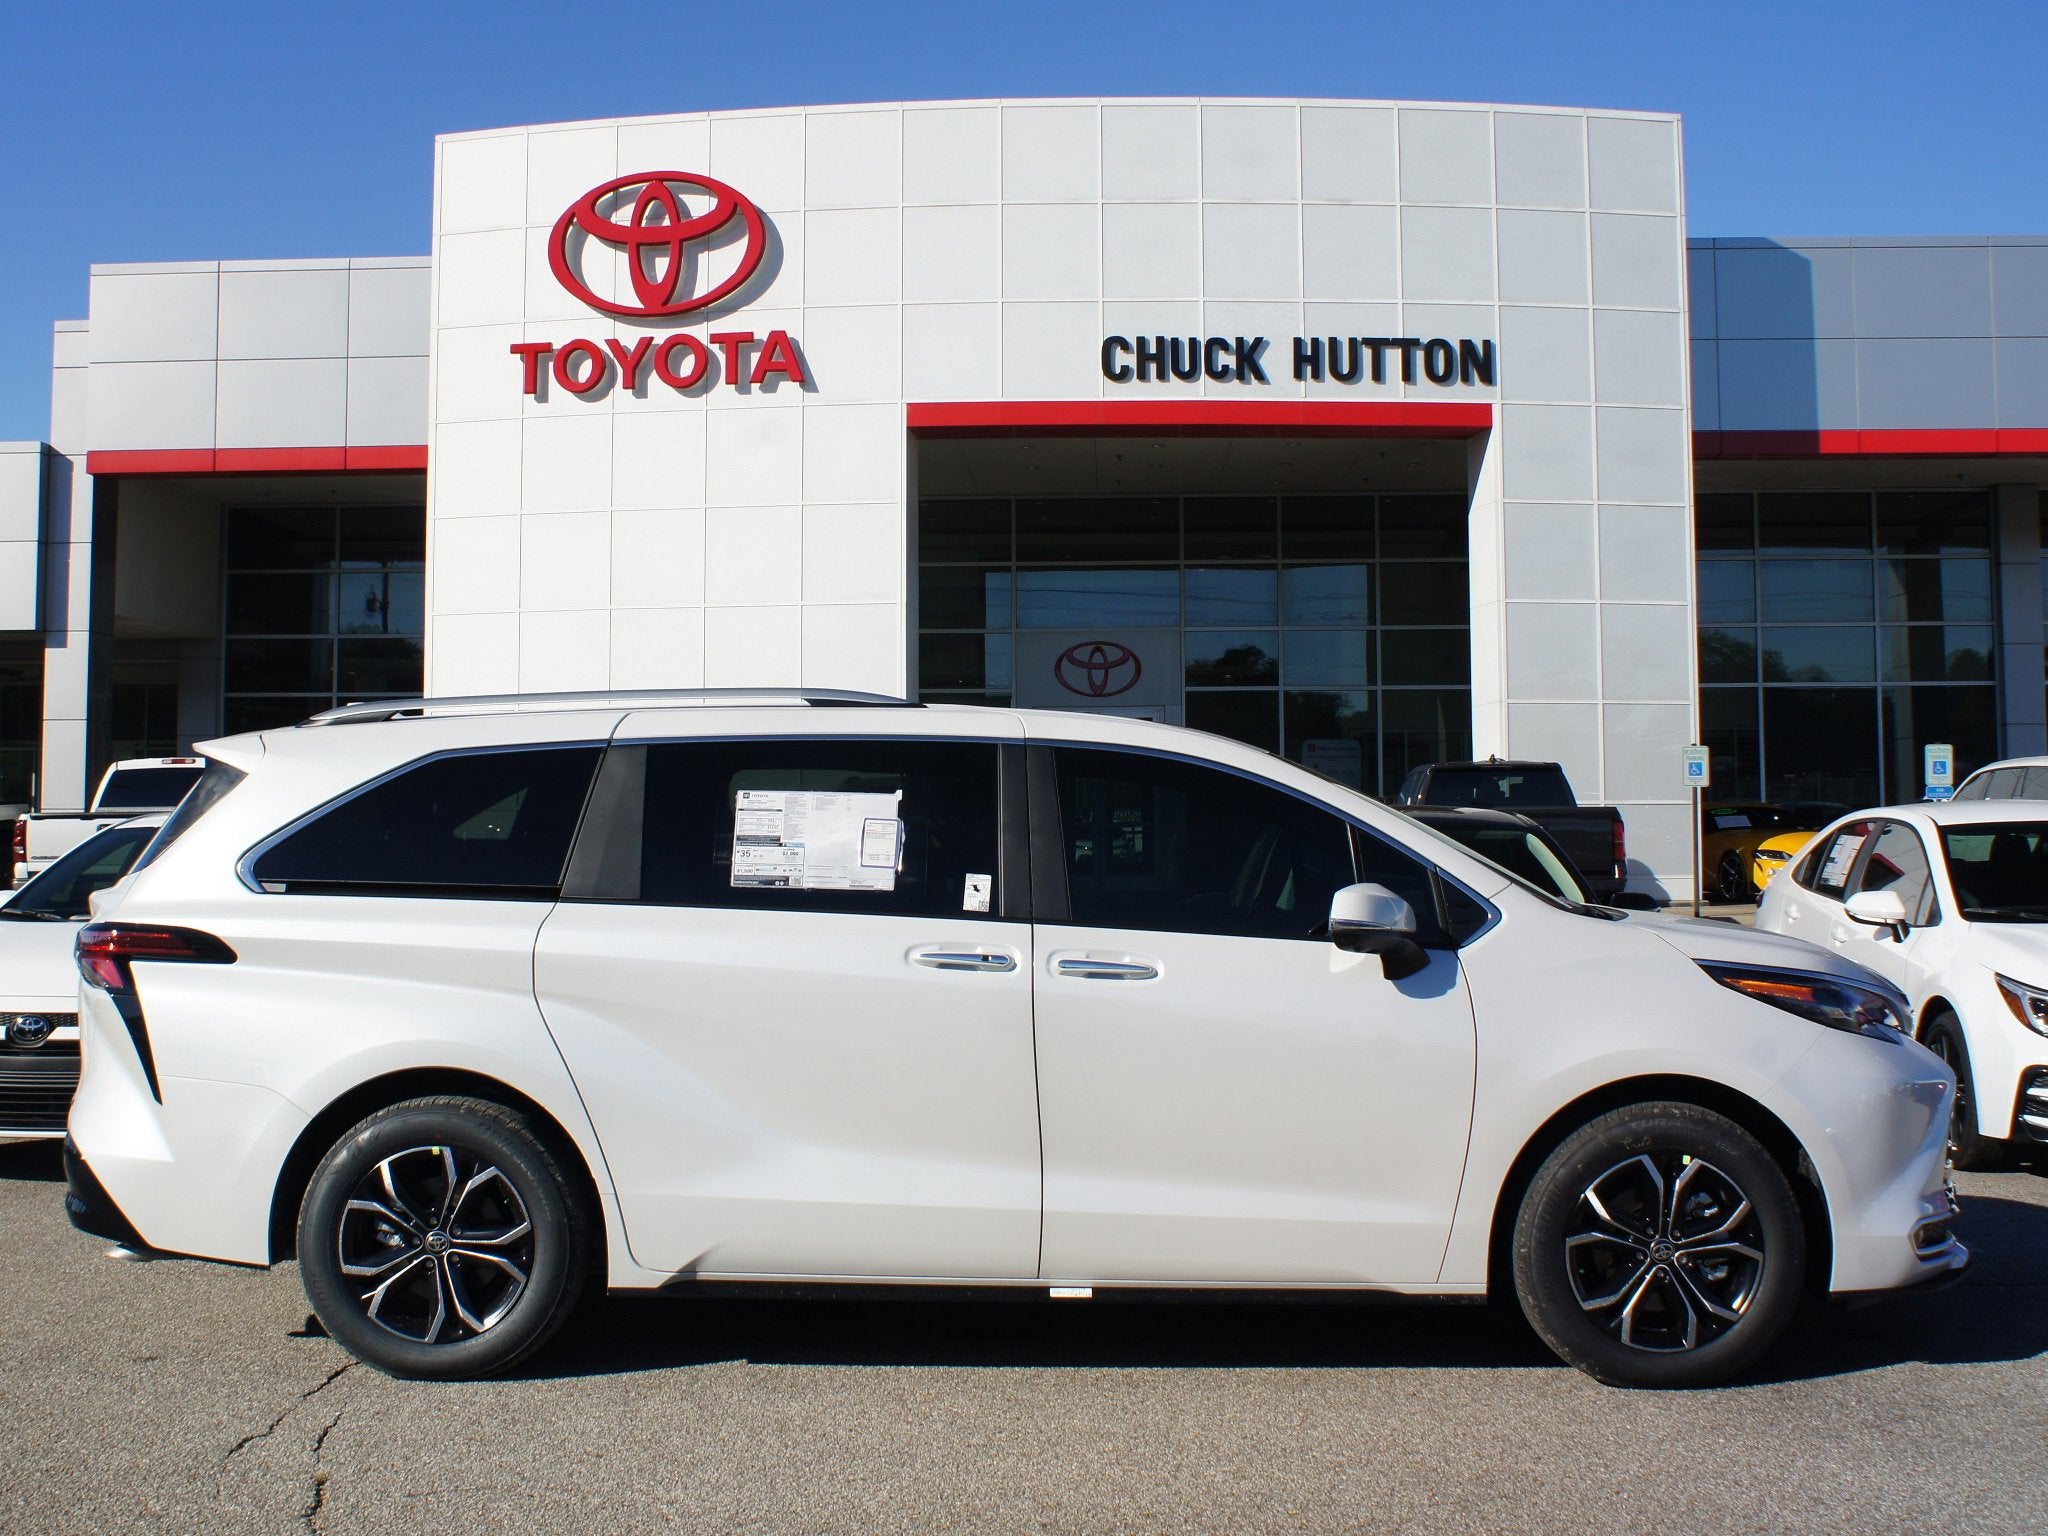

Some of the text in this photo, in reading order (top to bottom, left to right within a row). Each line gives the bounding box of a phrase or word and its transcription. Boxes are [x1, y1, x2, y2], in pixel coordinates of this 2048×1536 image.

[511, 330, 803, 393] TOYOTA
[1102, 335, 1492, 385] CHUCK HUTTON
[740, 849, 751, 858] 35
